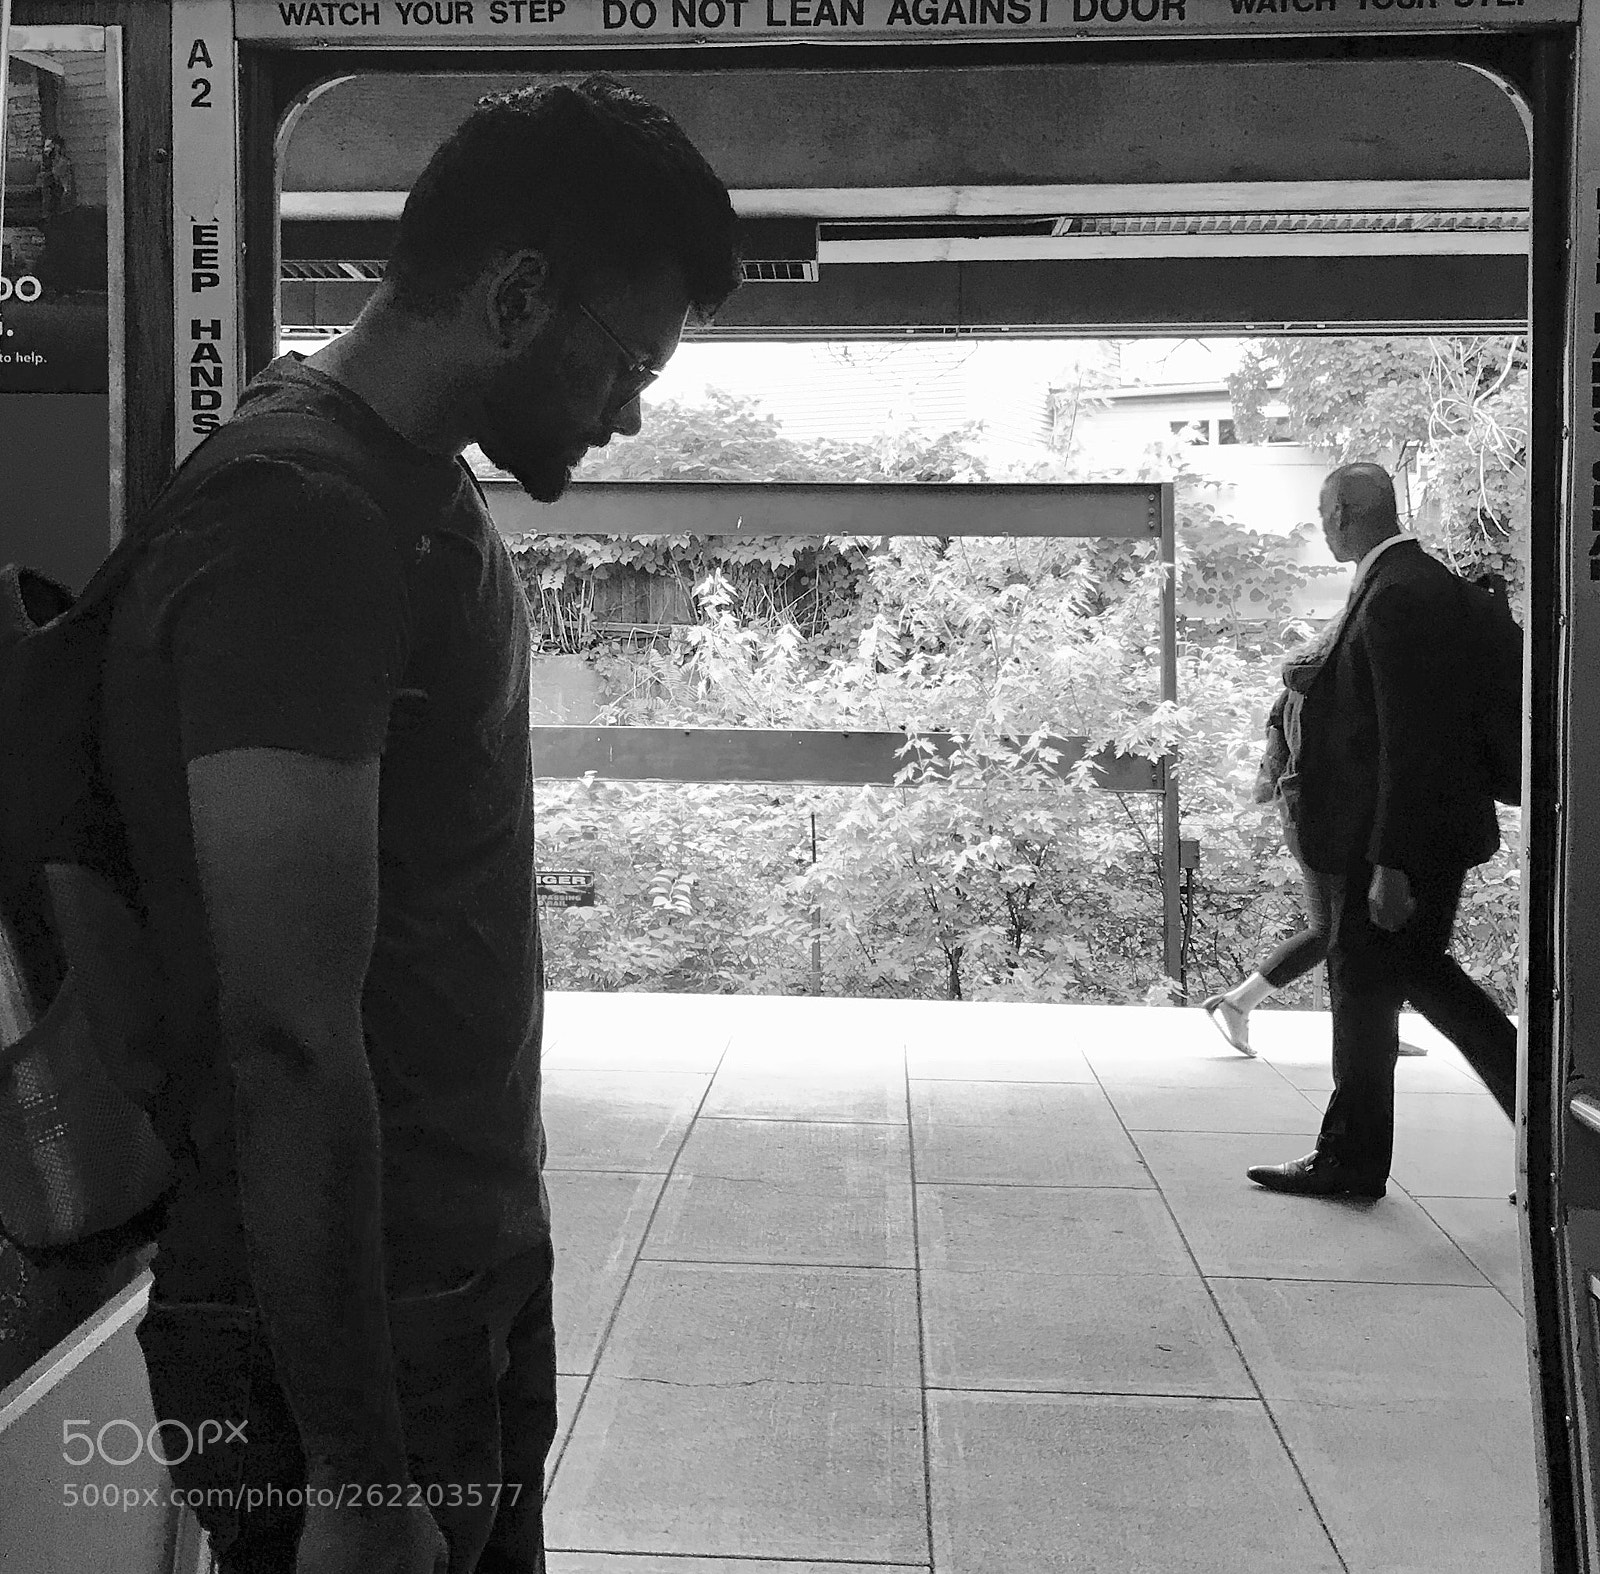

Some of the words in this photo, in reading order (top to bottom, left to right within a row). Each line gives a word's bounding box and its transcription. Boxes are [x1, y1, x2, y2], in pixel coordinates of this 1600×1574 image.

[279, 2, 380, 26] WATCH
[395, 1, 475, 26] YOUR
[490, 0, 567, 25] STEP
[602, 0, 657, 29] DO
[672, 0, 749, 28] NOT
[767, 0, 865, 27] LEAN
[886, 0, 1049, 26] AGAINST
[1073, 0, 1187, 23] DOOR
[190, 215, 220, 293] EEP
[15, 351, 48, 366] help.
